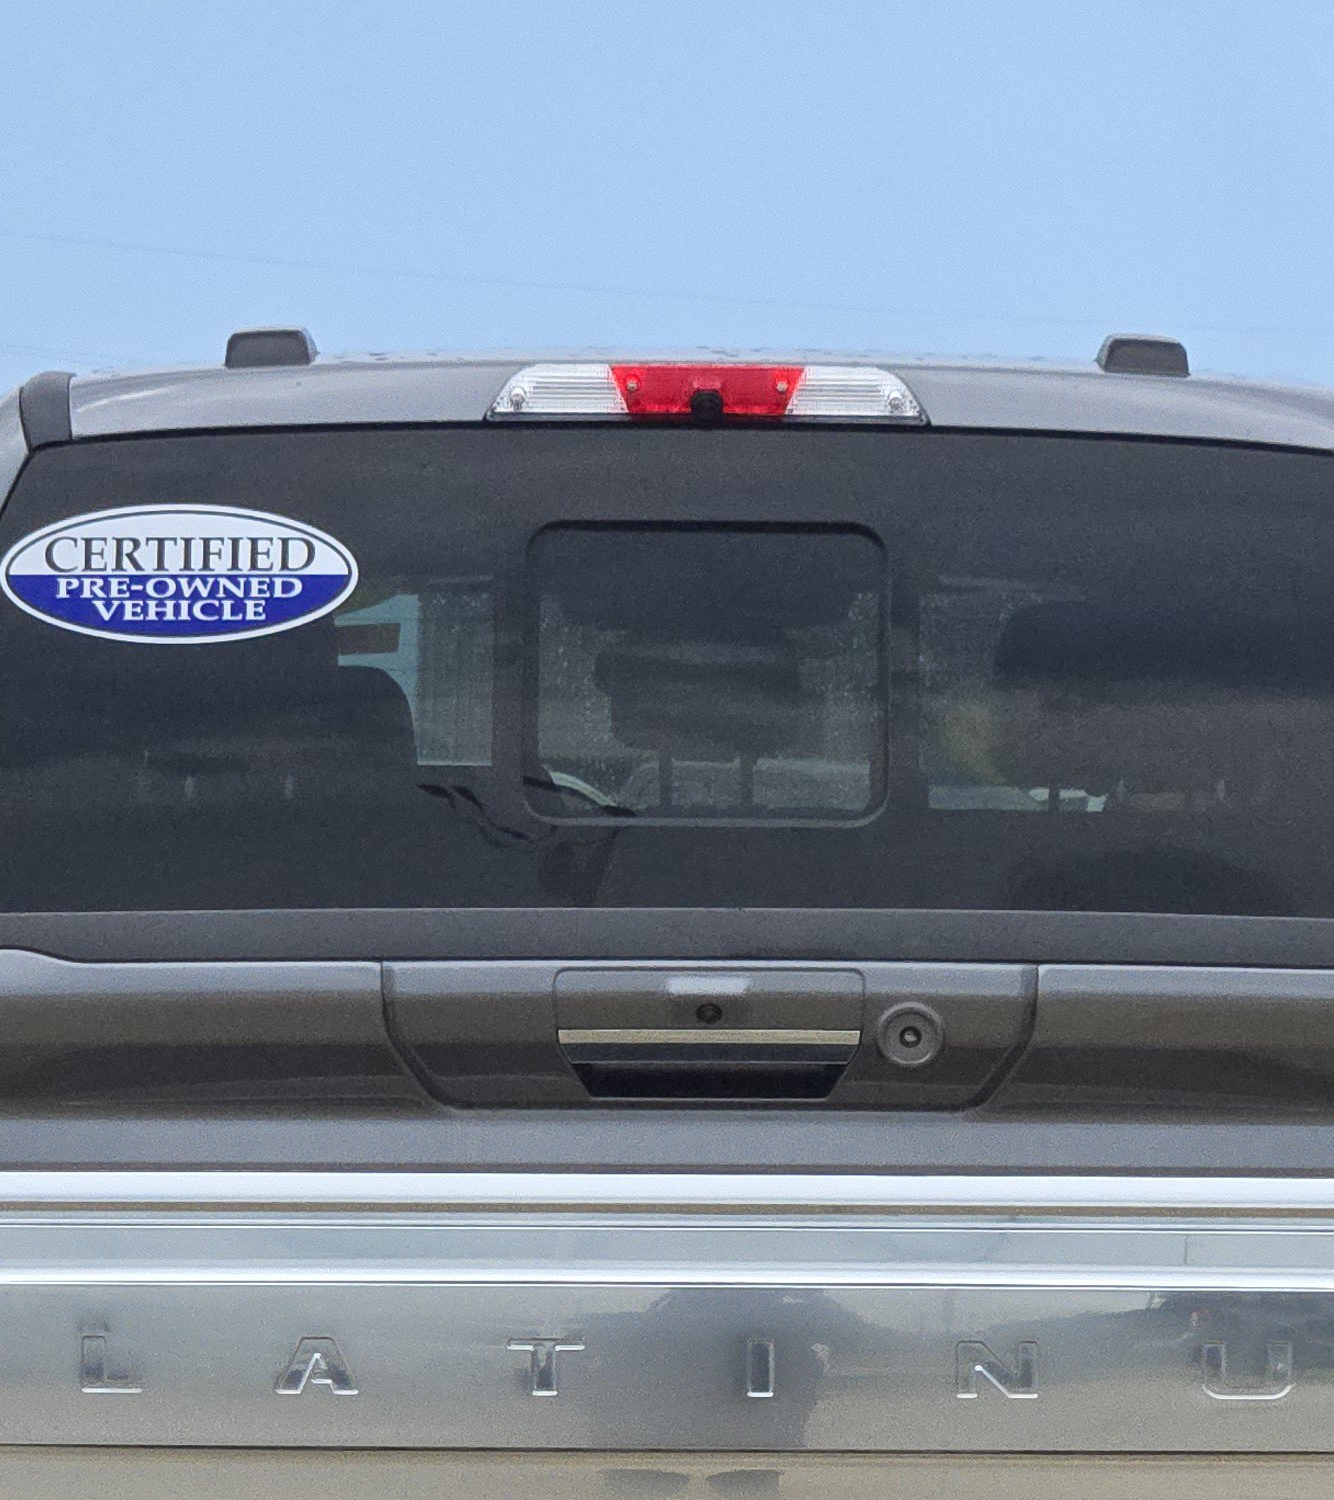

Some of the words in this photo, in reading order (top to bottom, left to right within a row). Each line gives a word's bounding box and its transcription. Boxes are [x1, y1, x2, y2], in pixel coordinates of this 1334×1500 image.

[44, 536, 316, 573] CERTIFIED
[55, 577, 303, 600] PRE-OWNED
[92, 600, 266, 622] VEHICLE
